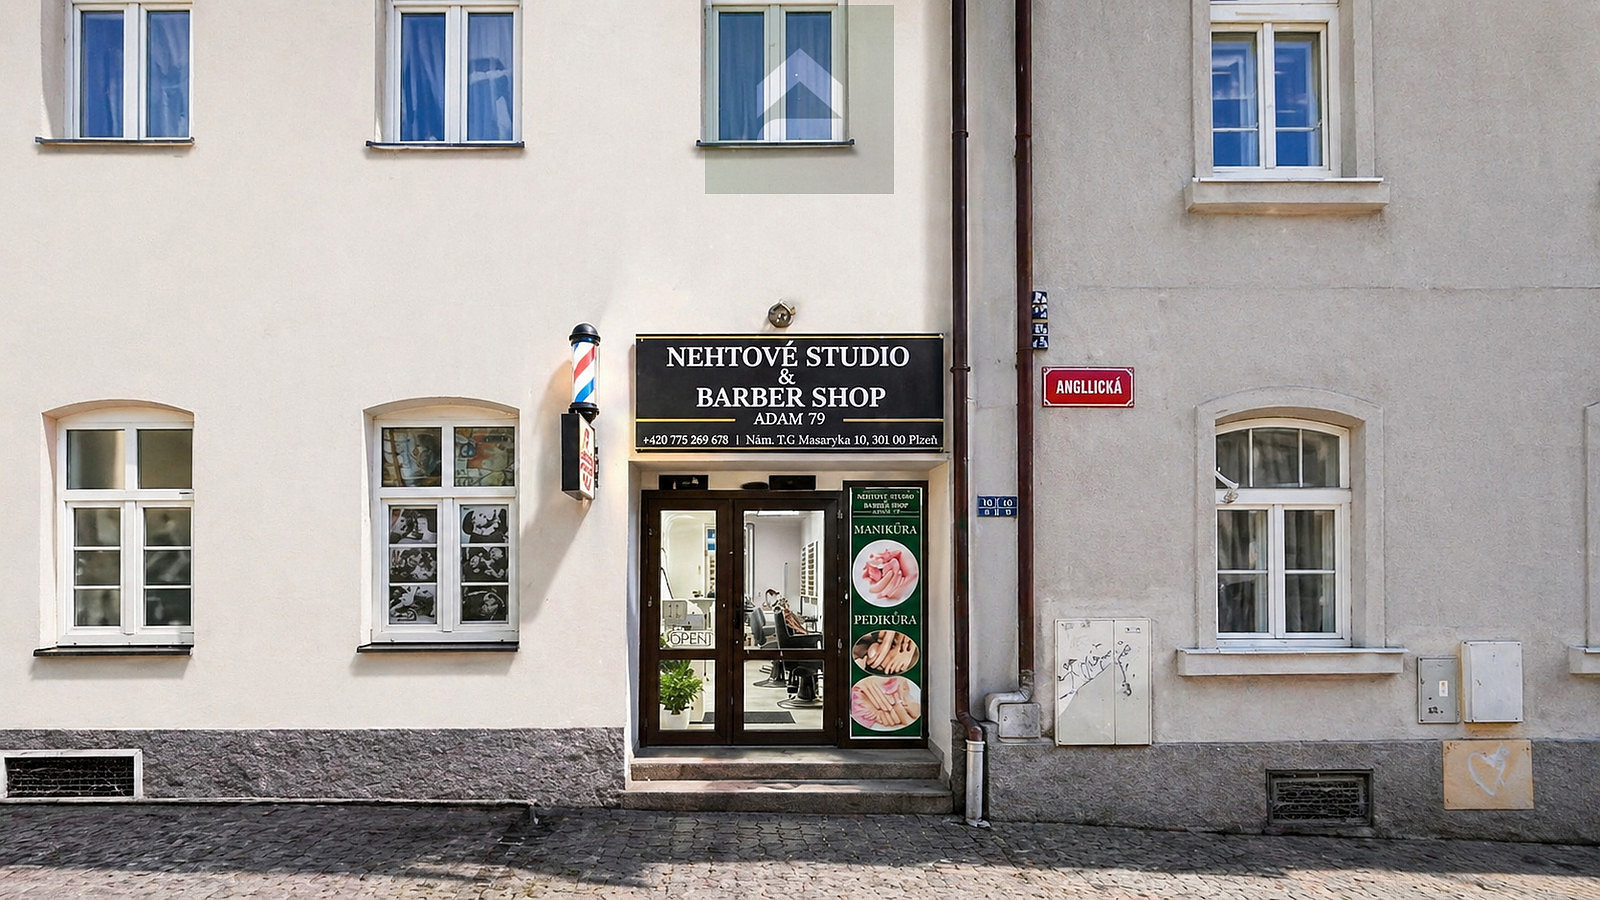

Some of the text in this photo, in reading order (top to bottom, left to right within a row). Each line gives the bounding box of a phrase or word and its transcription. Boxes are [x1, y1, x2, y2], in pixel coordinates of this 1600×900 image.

[666, 340, 910, 367] NEHTOVÉ STUDIO
[778, 368, 796, 385] &
[1056, 377, 1123, 394] ANGLLICKÁ
[696, 386, 886, 408] BARBER SHOP
[753, 412, 826, 425] ADAM 79
[642, 434, 938, 447] +420 775 269 678 Nám. T.G Masaryka 10, 301 00 Plzeň
[670, 631, 708, 645] OPEN
